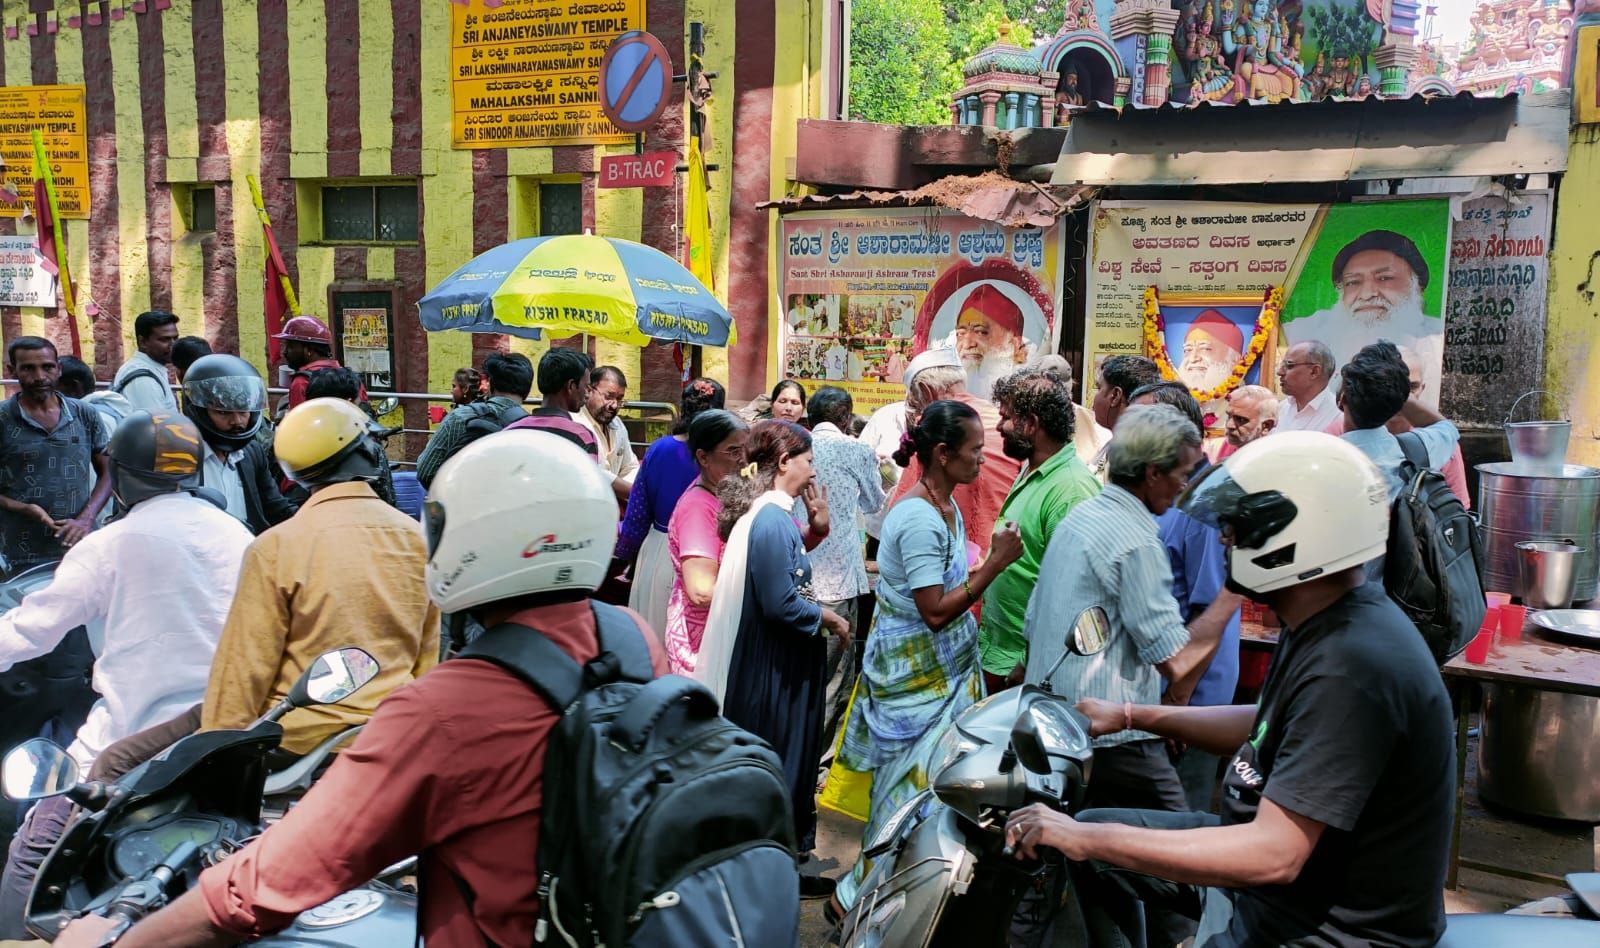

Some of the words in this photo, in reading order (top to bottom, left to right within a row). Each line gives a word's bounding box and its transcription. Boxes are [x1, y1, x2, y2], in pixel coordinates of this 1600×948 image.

[569, 1, 626, 15] ದೇವಾಲಯ
[463, 29, 479, 44] SRI
[482, 21, 578, 42] ANJANEYASWAMY
[582, 18, 628, 33] TEMPLE
[460, 65, 473, 77] SRI
[474, 57, 585, 76] LAKSHMINARAYANASWAMY
[470, 93, 555, 109] MAHALAKSHMI
[47, 122, 77, 133] TEMPLE
[464, 127, 477, 141] SRI
[478, 126, 513, 140] SINDOOR
[514, 123, 584, 139] ANJANEYASWAMY
[52, 150, 80, 160] SANNIDHI
[608, 159, 665, 181] B-TRAC
[1150, 215, 1172, 226] ಸಂತ
[1175, 214, 1188, 229] ಶ್ರೀ
[788, 230, 823, 256] ಸಂತ
[828, 230, 850, 264] ಶ್ರೀ
[1208, 234, 1251, 249] ದಿವಸ
[810, 269, 828, 278] Shri
[875, 269, 910, 278] Ashram
[1247, 257, 1288, 274] ದಿವಸ
[523, 305, 560, 321] RISHI
[563, 306, 609, 325] PRASAD
[650, 311, 676, 329] RISHI
